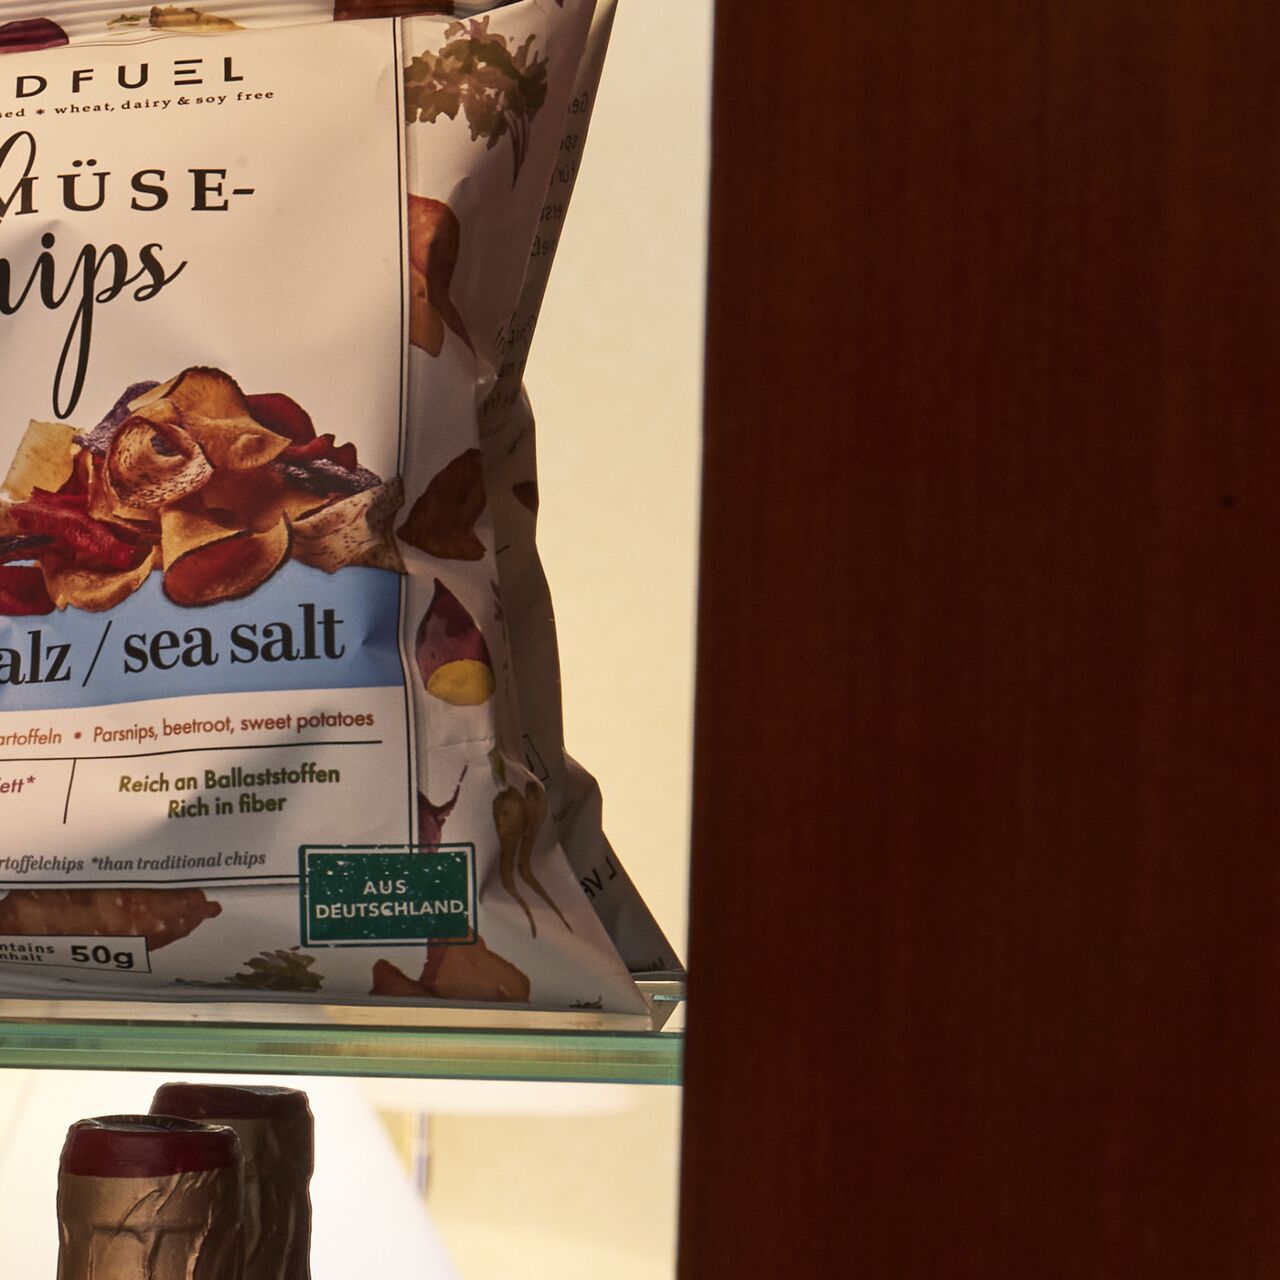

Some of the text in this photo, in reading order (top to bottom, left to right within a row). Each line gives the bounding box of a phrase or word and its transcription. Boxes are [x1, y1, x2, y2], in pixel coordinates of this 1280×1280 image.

[54, 102, 116, 115] wheat,
[121, 98, 172, 111] dairy
[177, 96, 191, 106] &
[196, 95, 227, 106] soy
[237, 90, 275, 101] free
[123, 627, 220, 675] sea
[229, 603, 346, 664] salt
[93, 723, 159, 744] Parsnips,
[162, 715, 235, 737] beetroot,
[241, 714, 292, 732] sweet
[297, 711, 375, 733] potatoes
[118, 762, 341, 793] Reich an Ballaststoffen
[167, 793, 287, 819] Rich in fiber
[136, 853, 221, 871] traditional
[225, 852, 266, 869] chips
[362, 879, 408, 896] AUS
[315, 899, 464, 920] DEUTSCHLAND
[70, 944, 135, 969] 50g
